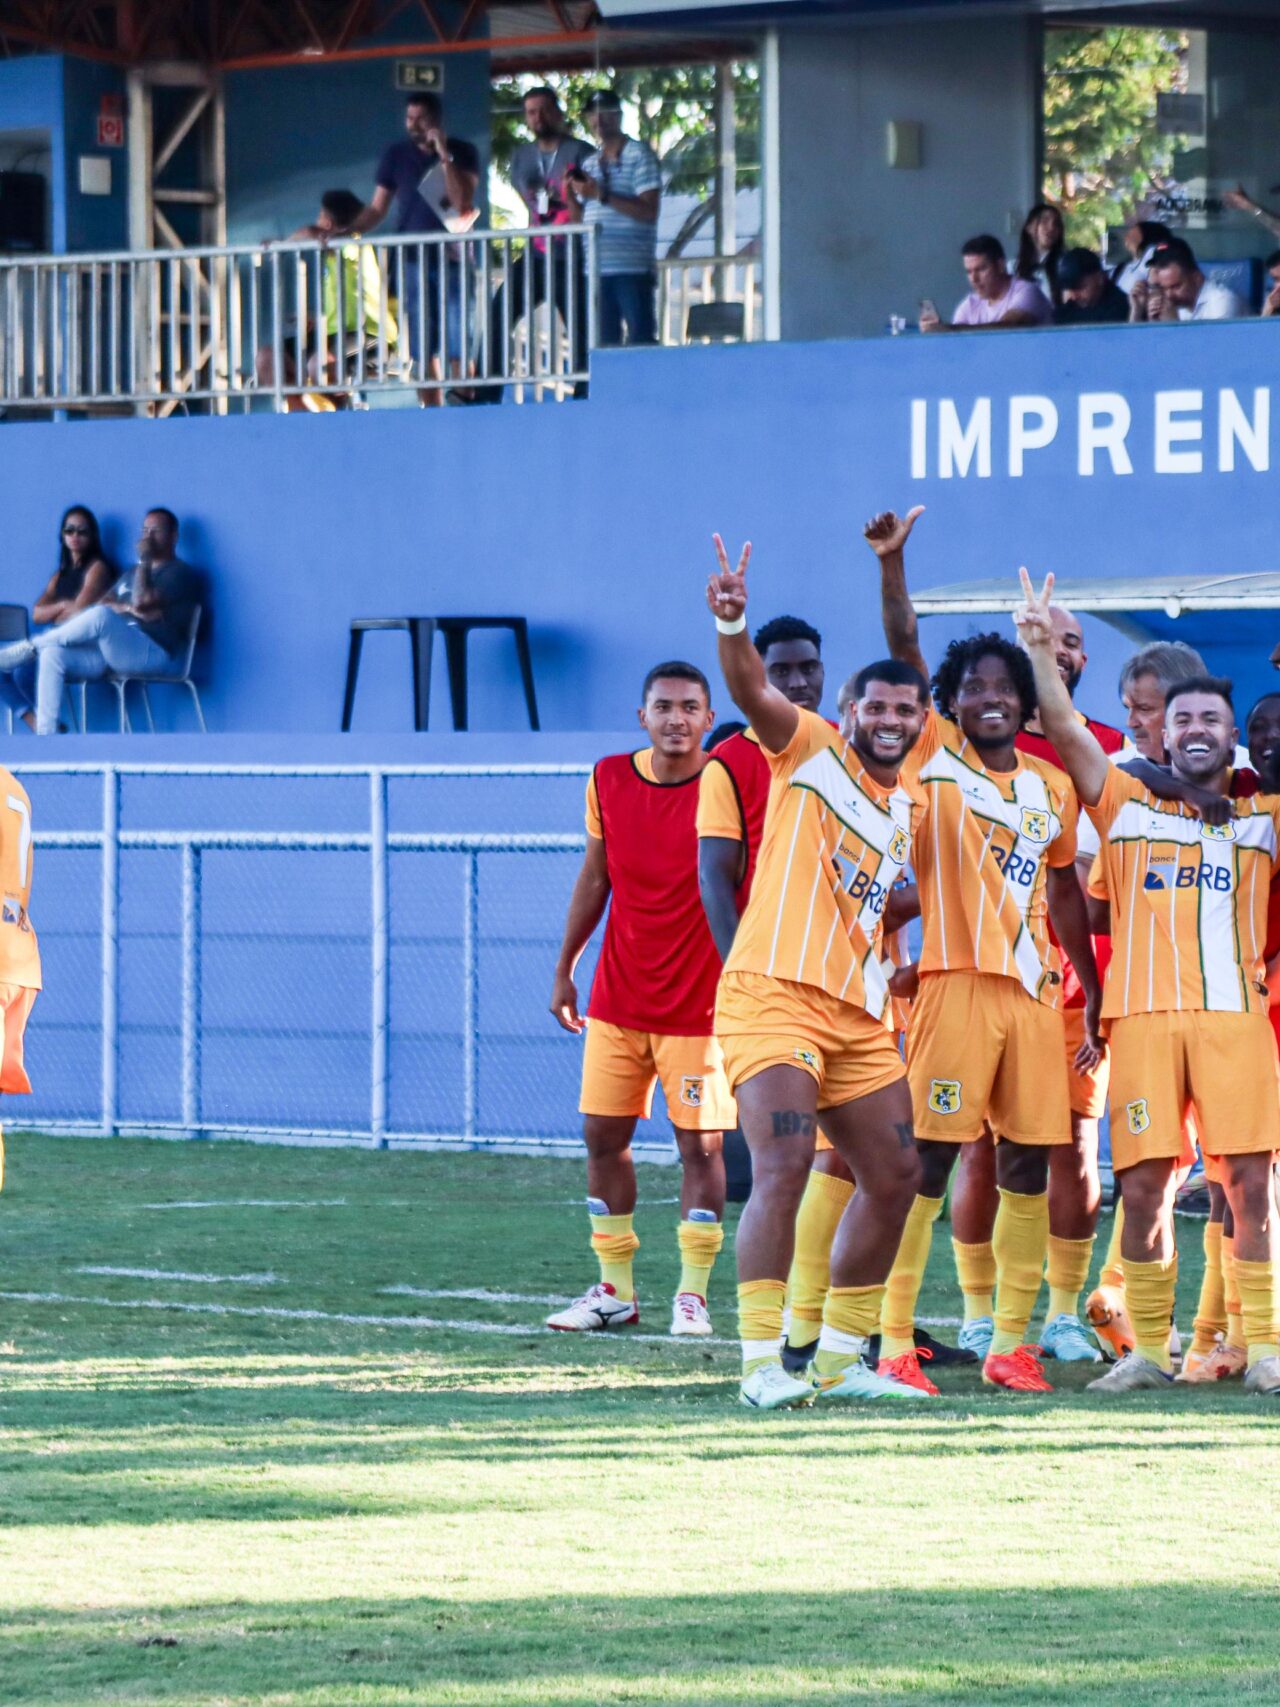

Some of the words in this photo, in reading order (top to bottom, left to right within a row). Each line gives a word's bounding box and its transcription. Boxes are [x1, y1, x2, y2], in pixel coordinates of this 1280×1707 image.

[838, 841, 861, 863] banco
[1175, 863, 1232, 892] BRB
[848, 870, 888, 915] BRB
